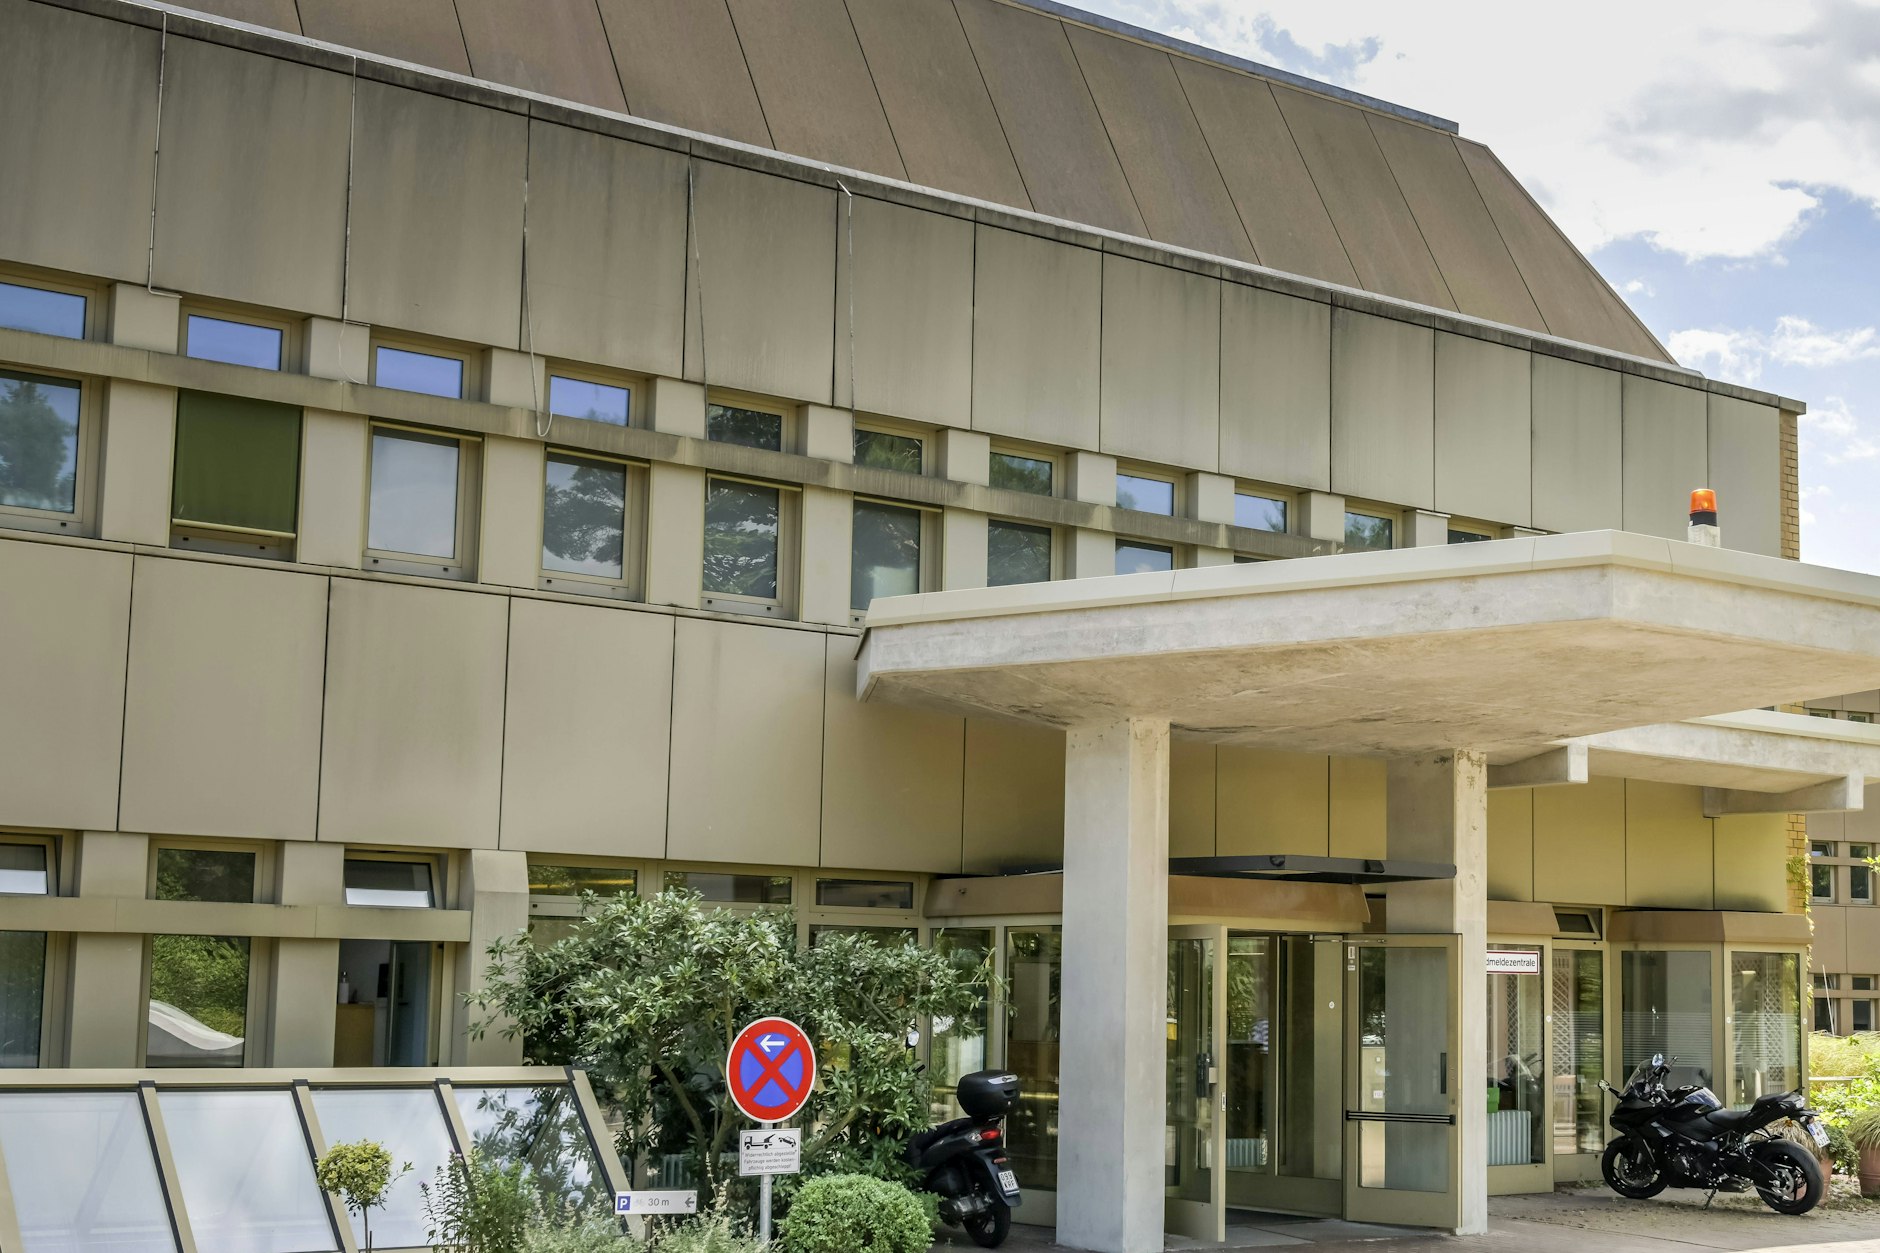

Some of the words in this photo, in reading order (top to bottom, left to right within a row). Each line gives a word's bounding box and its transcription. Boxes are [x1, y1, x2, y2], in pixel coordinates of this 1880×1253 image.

[1487, 957, 1536, 967] dmeldezentrale
[620, 1198, 628, 1209] P
[648, 1197, 660, 1207] 30
